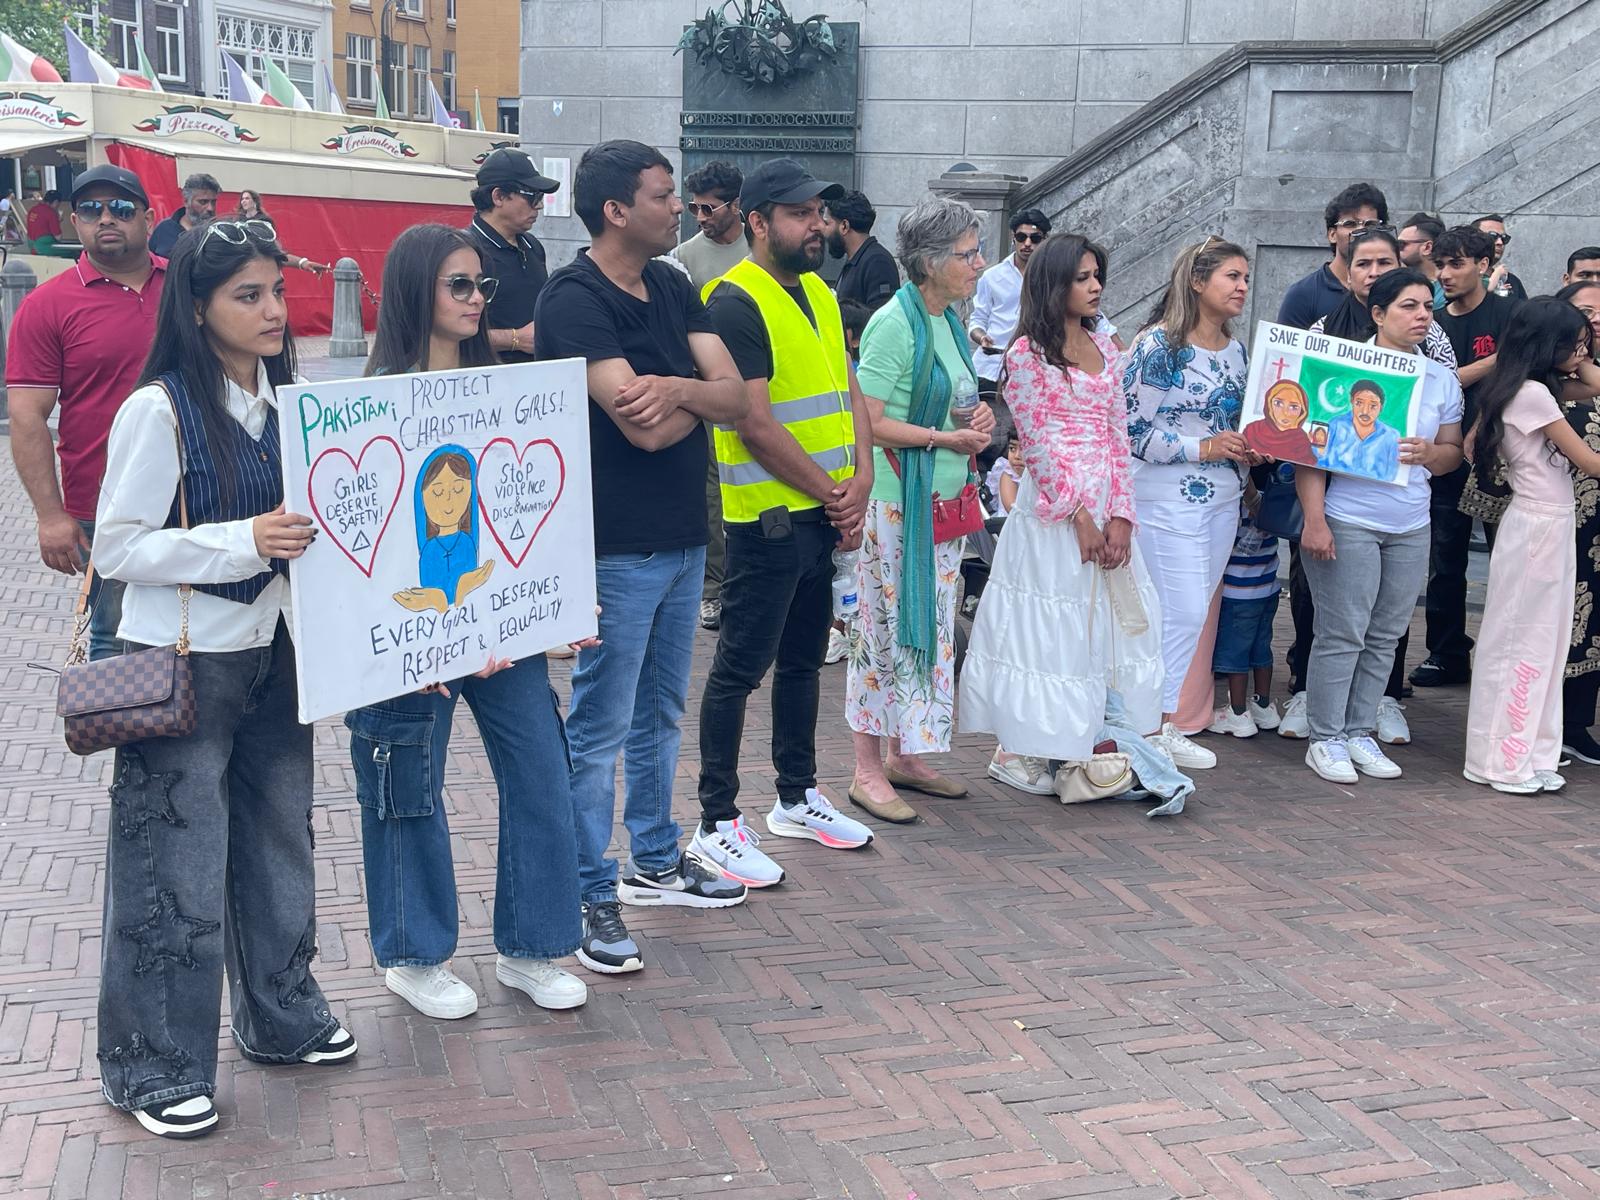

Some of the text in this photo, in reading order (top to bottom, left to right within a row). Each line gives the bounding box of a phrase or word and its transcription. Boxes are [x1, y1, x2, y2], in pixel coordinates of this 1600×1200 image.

[0, 104, 56, 126] issanterie
[167, 115, 230, 139] Pizzeria
[1269, 327, 1417, 374] SAVE OUR DAUGHTERS
[411, 374, 492, 416] PROTECT
[399, 390, 564, 451] CHRISTIAN GIRLS!
[334, 472, 378, 500] GIRLS
[515, 495, 521, 507] &
[326, 492, 378, 520] DESERVE
[338, 506, 383, 534] SAFETY!
[370, 615, 437, 656] EVERY
[490, 575, 560, 611] DESERVES
[403, 597, 563, 686] RESPECT & EQUALITY
[1501, 659, 1541, 771] My Melody
